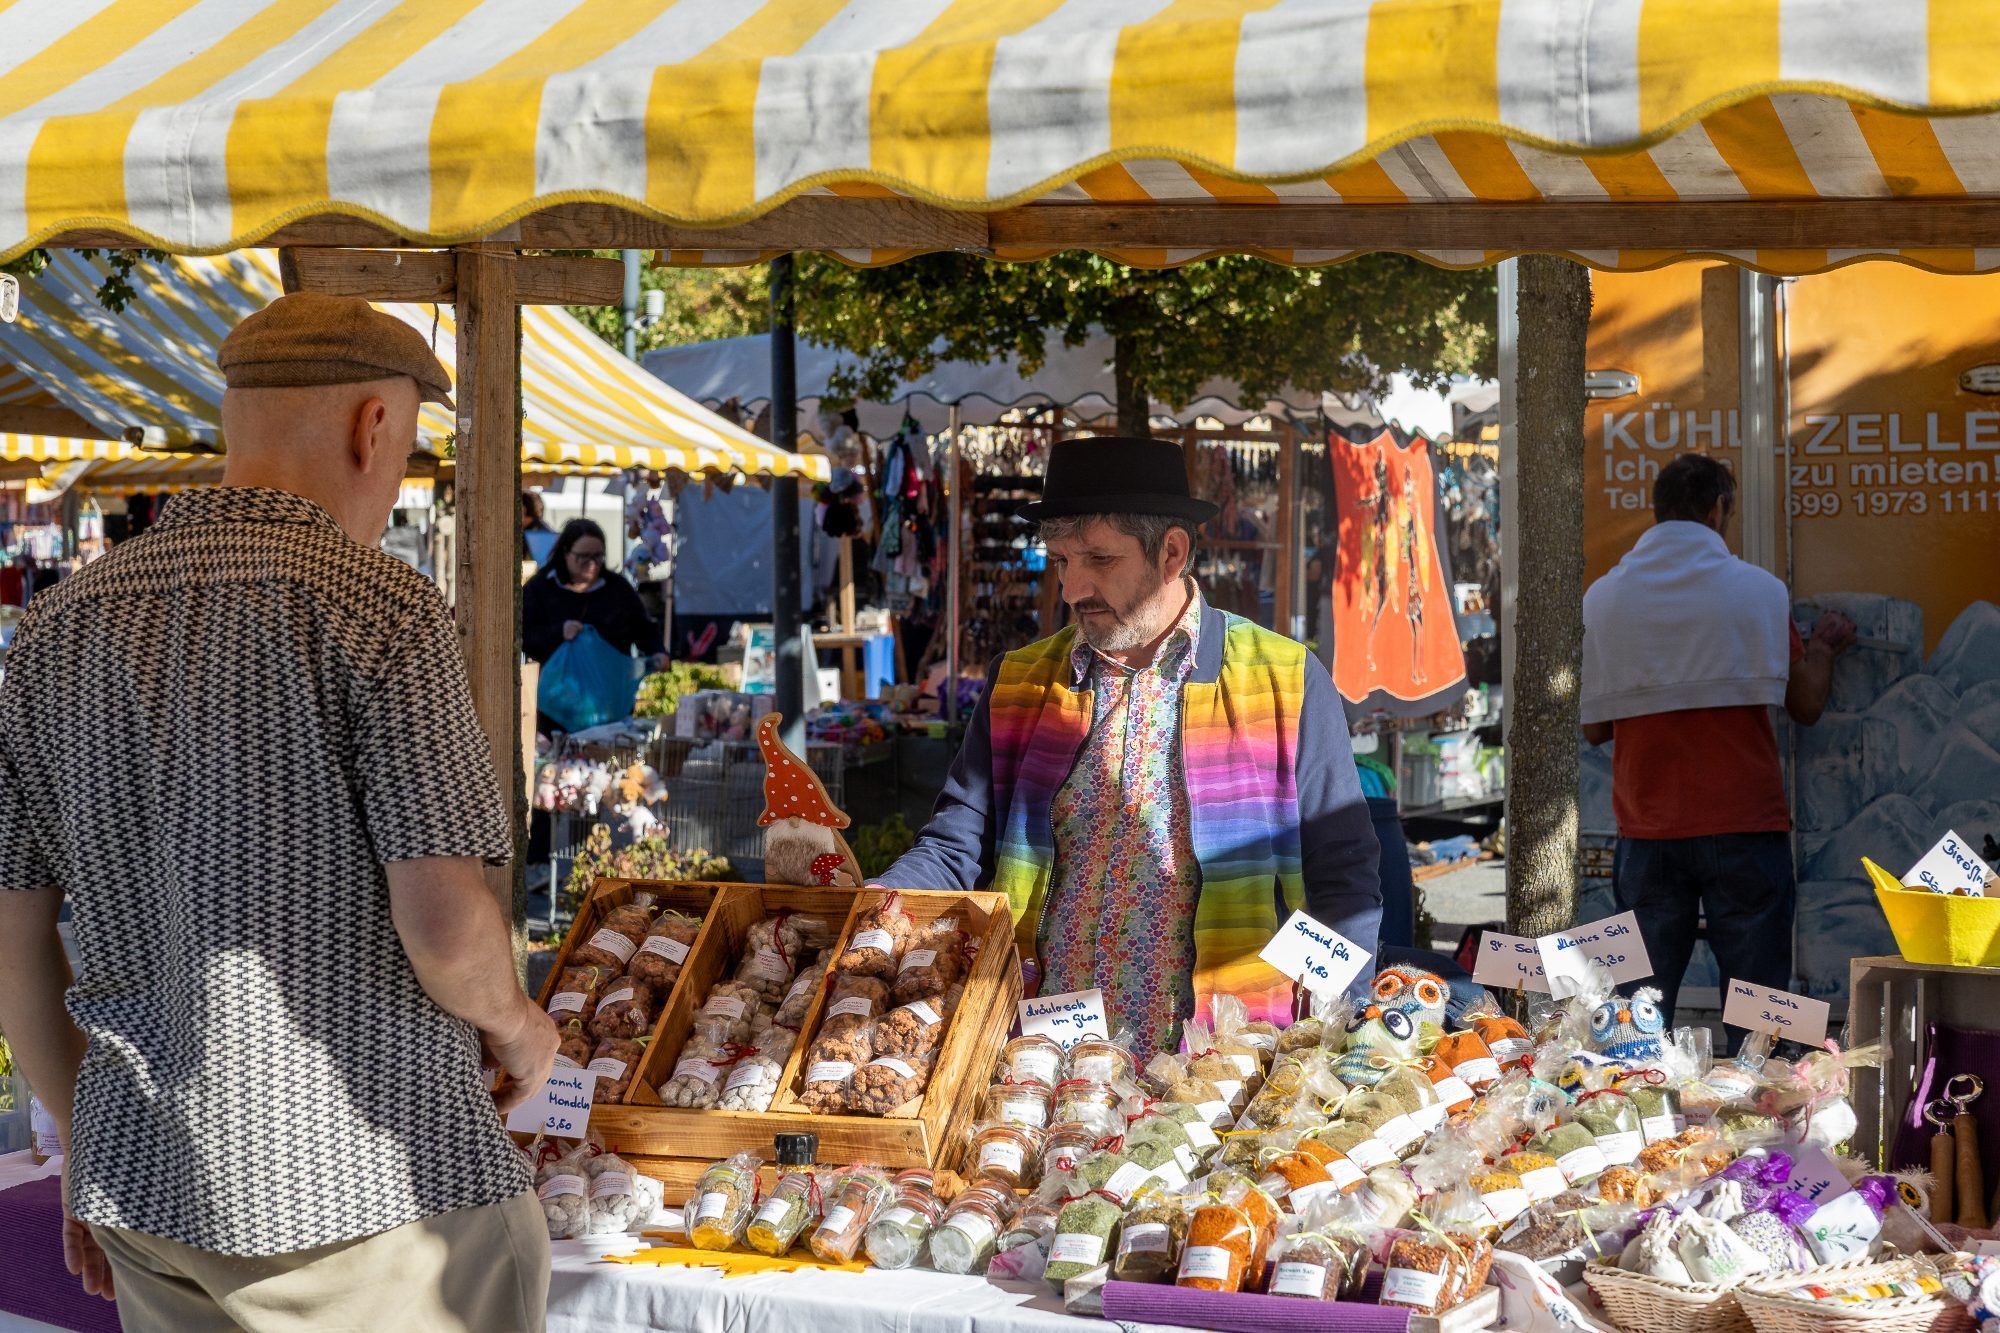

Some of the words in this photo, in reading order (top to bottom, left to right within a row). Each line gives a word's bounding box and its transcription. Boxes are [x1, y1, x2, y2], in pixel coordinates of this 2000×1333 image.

[1805, 411, 2000, 454] ZELLE
[1604, 453, 1660, 482] Ich
[1790, 463, 1834, 487] zu
[1851, 455, 2000, 486] mieten!
[1853, 490, 1927, 515] 1973
[1603, 925, 1630, 938] Salz
[1514, 943, 1540, 955] Sal
[1594, 953, 1626, 968] 3,30
[1517, 962, 1545, 977] 4,3
[1768, 994, 1799, 1010] Salz
[1072, 1013, 1099, 1029] Glas
